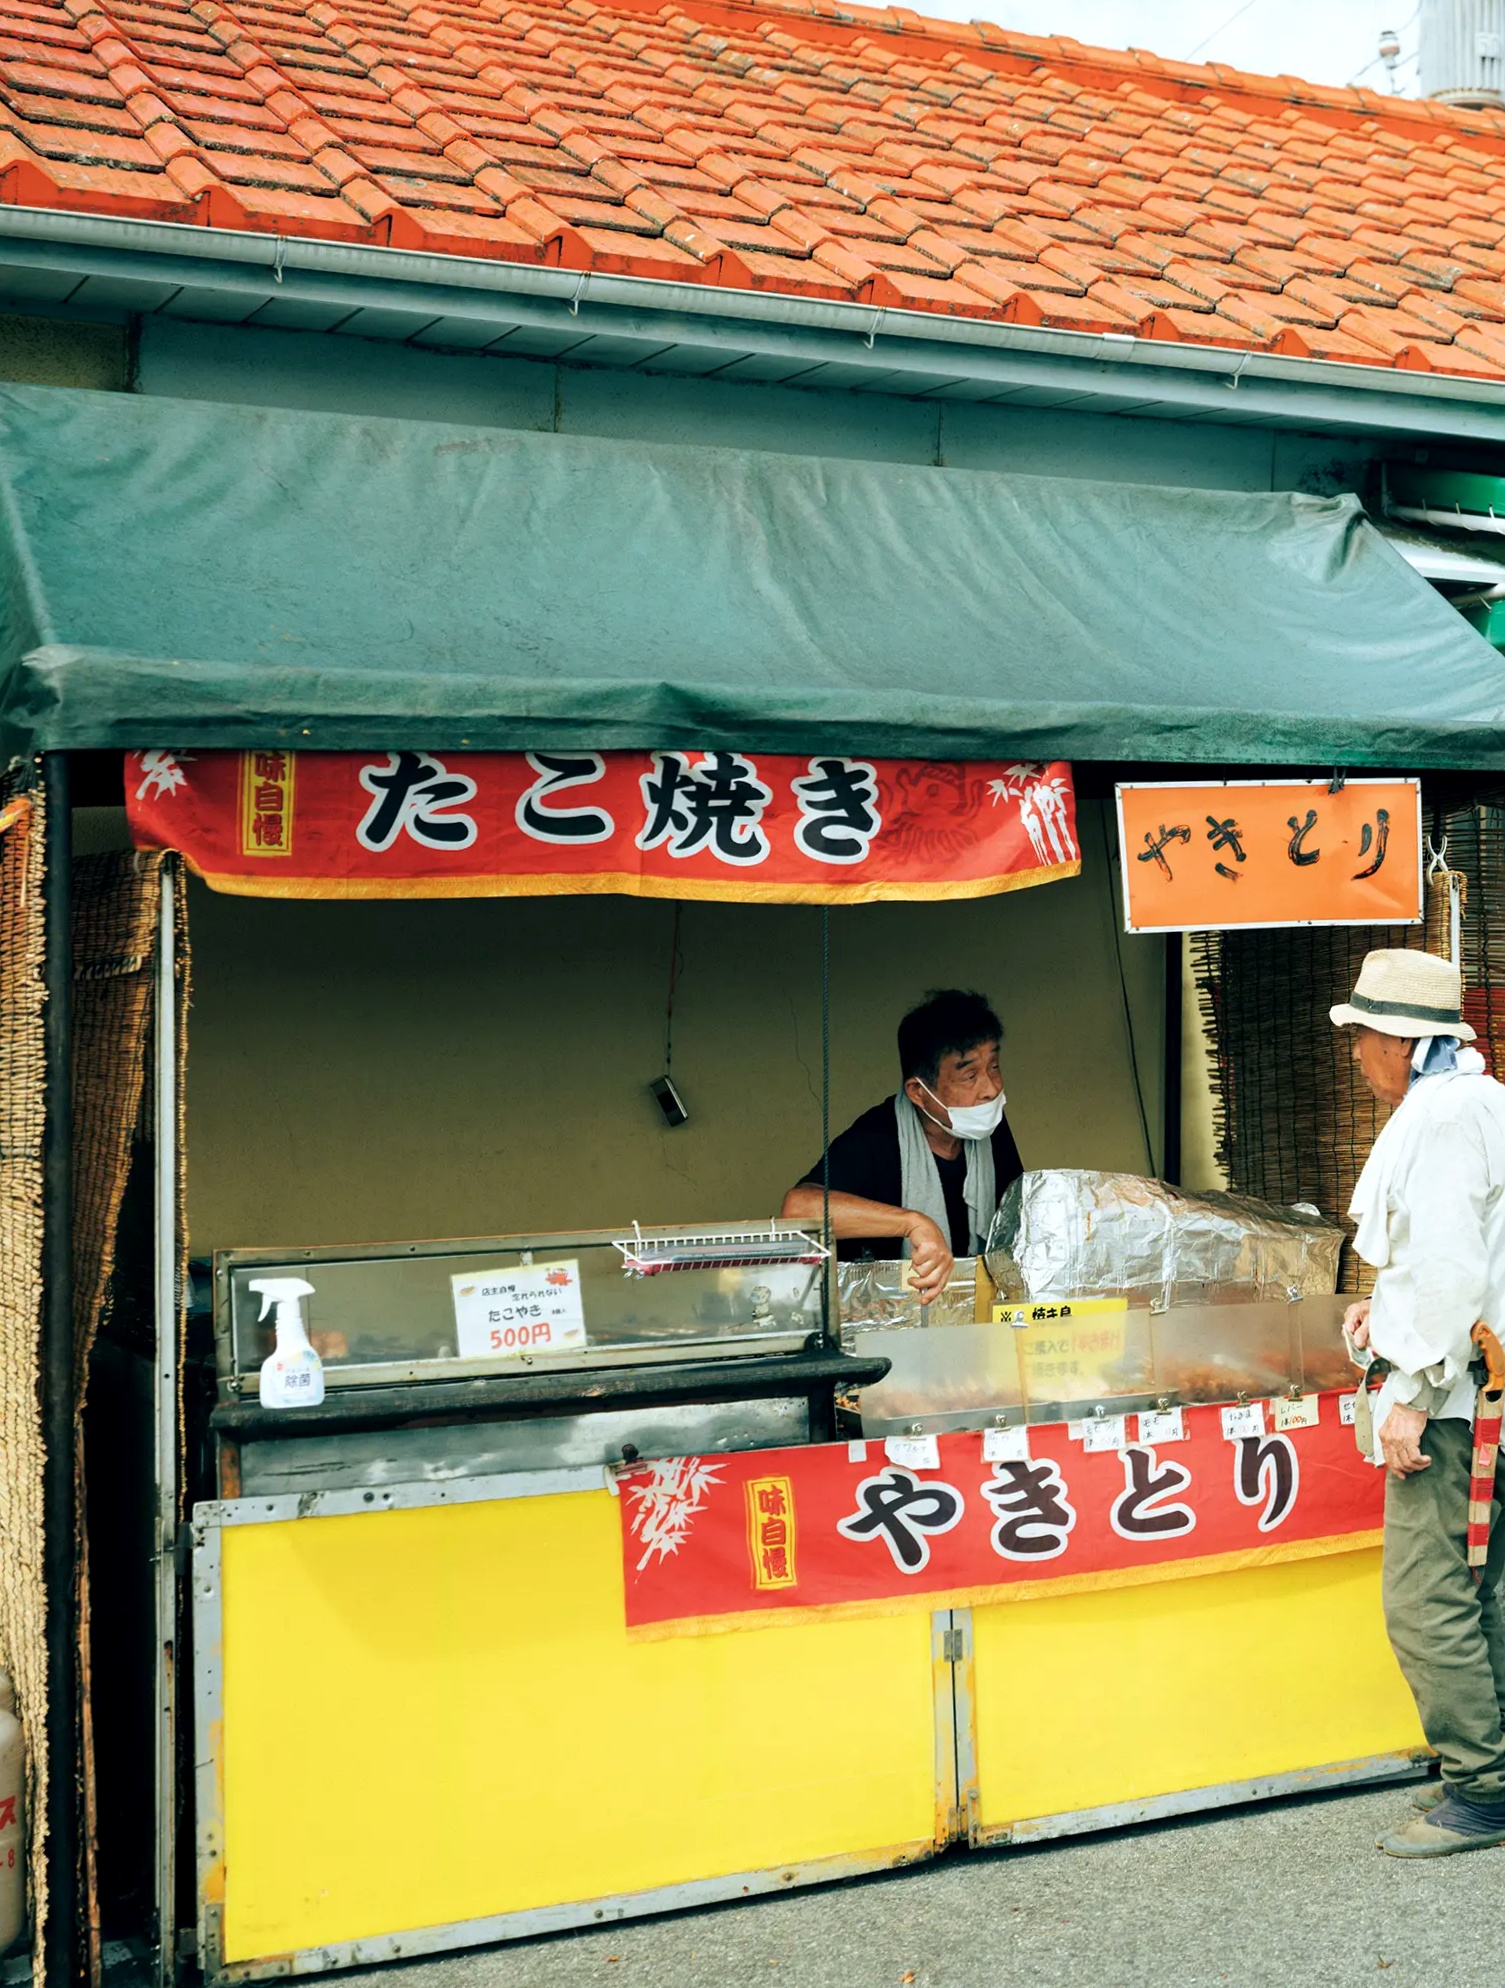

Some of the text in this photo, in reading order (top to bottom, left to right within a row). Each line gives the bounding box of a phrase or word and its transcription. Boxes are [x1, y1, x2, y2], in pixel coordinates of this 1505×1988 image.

[252, 751, 286, 846] 味自慢
[356, 751, 880, 866] たこ焼き
[1137, 808, 1390, 881] やきとり
[488, 1304, 542, 1322] たこやき
[490, 1322, 551, 1349] 500円
[757, 1484, 788, 1580] 味自慢
[837, 1433, 1299, 1574] やきとり
